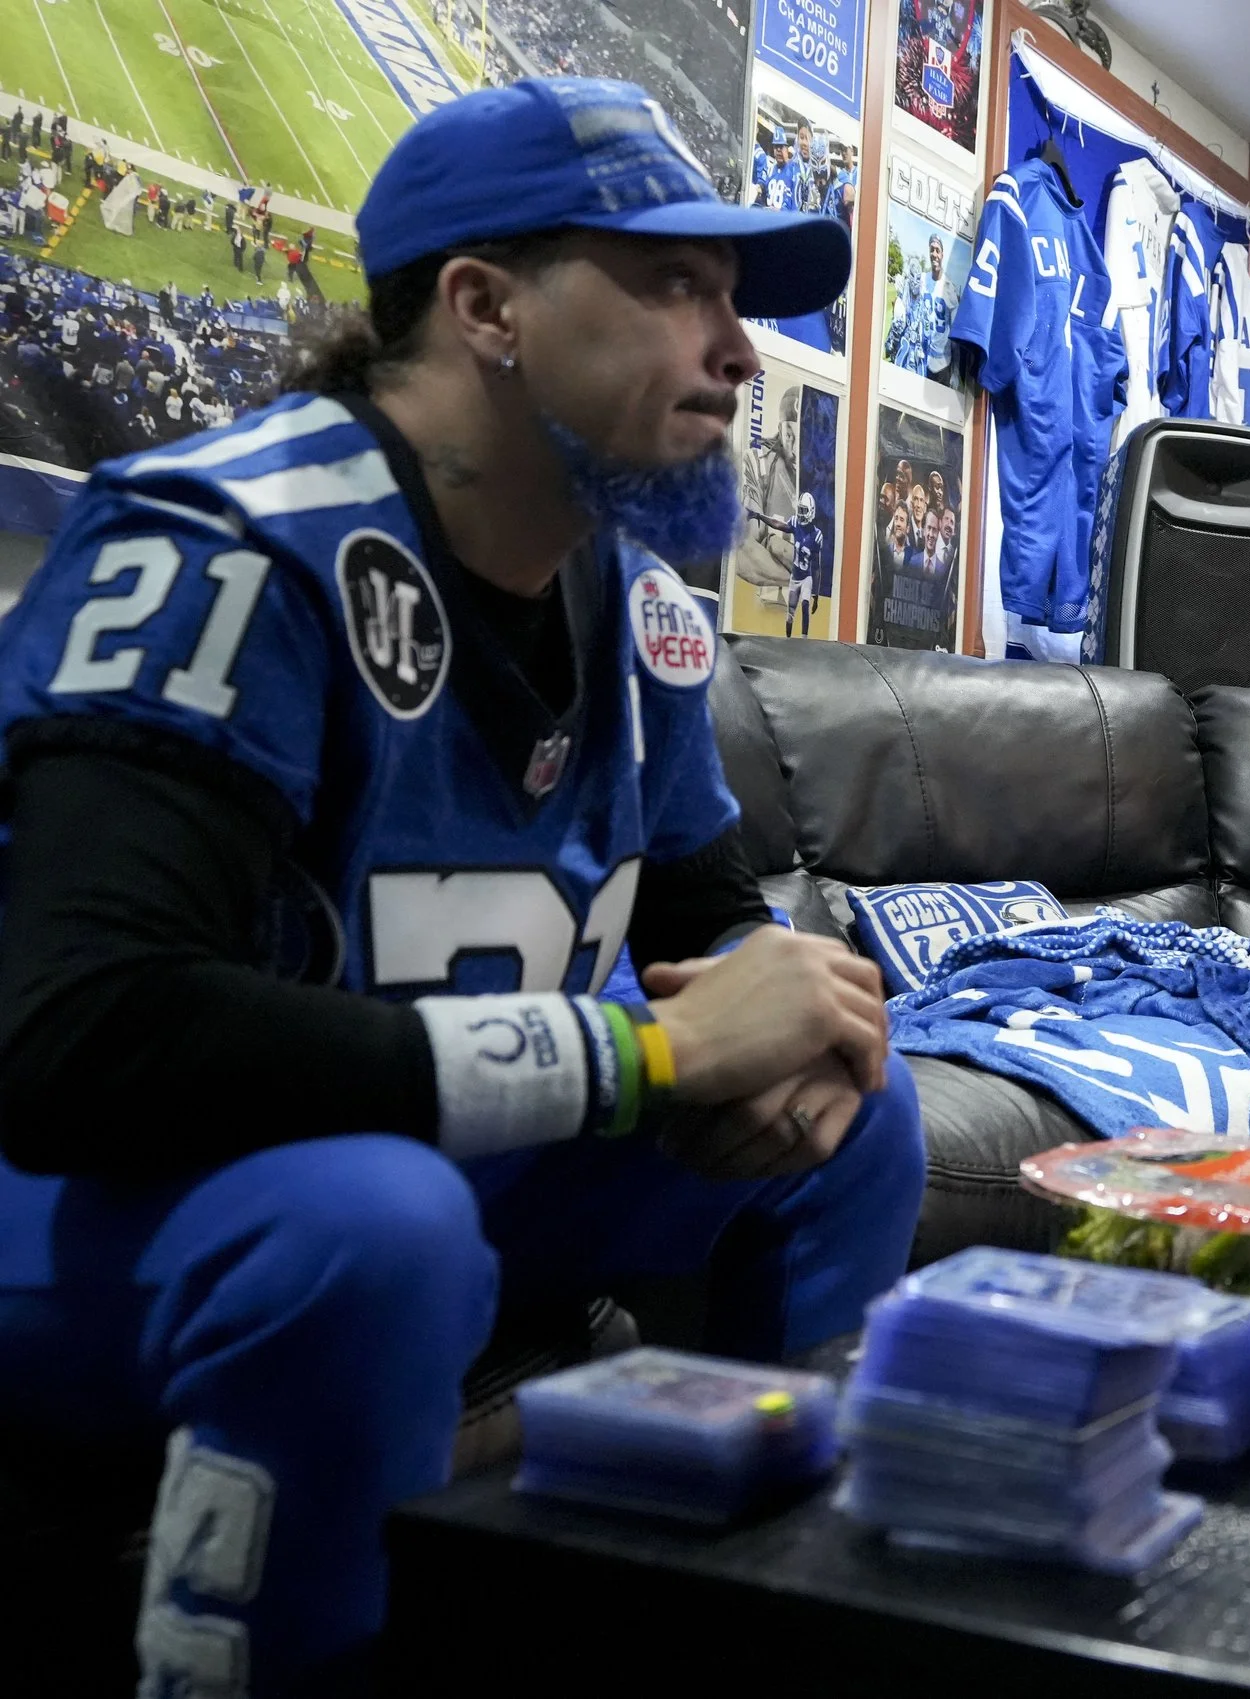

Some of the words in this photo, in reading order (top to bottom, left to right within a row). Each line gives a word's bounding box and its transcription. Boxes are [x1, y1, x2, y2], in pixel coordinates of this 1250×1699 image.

[778, 1, 848, 57] CHAMPIONS
[785, 25, 839, 76] 2006
[930, 68, 948, 88] HALL
[888, 155, 975, 243] COLTS
[968, 238, 1000, 299] 5
[750, 368, 766, 450] HILTON
[46, 535, 273, 719] 21
[641, 600, 688, 635] FAN
[883, 597, 940, 633] CHAMPIONS
[645, 634, 710, 670] YEAR
[883, 892, 961, 932] COLTS
